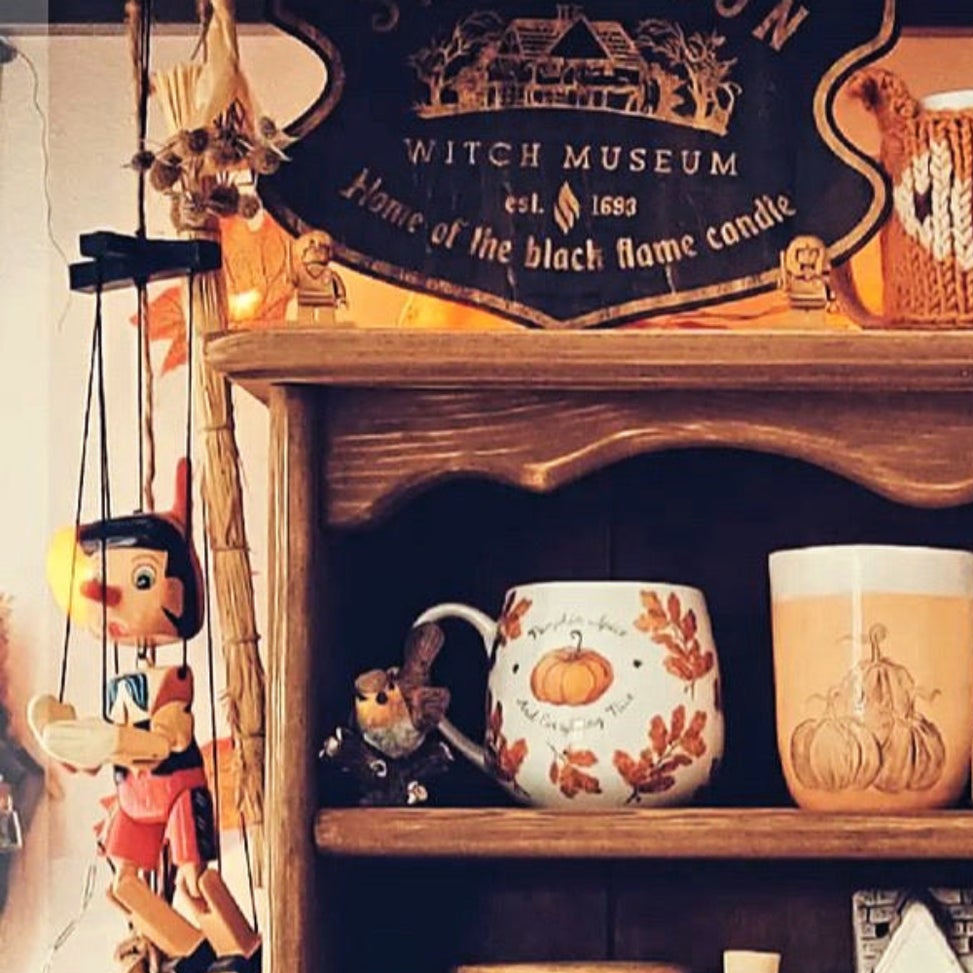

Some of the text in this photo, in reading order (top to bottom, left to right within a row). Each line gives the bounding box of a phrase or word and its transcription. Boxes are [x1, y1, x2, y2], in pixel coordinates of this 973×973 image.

[404, 138, 738, 176] WITCH MUSEUM
[339, 168, 796, 271] Home of the black flame candle
[504, 192, 638, 217] est. 1693
